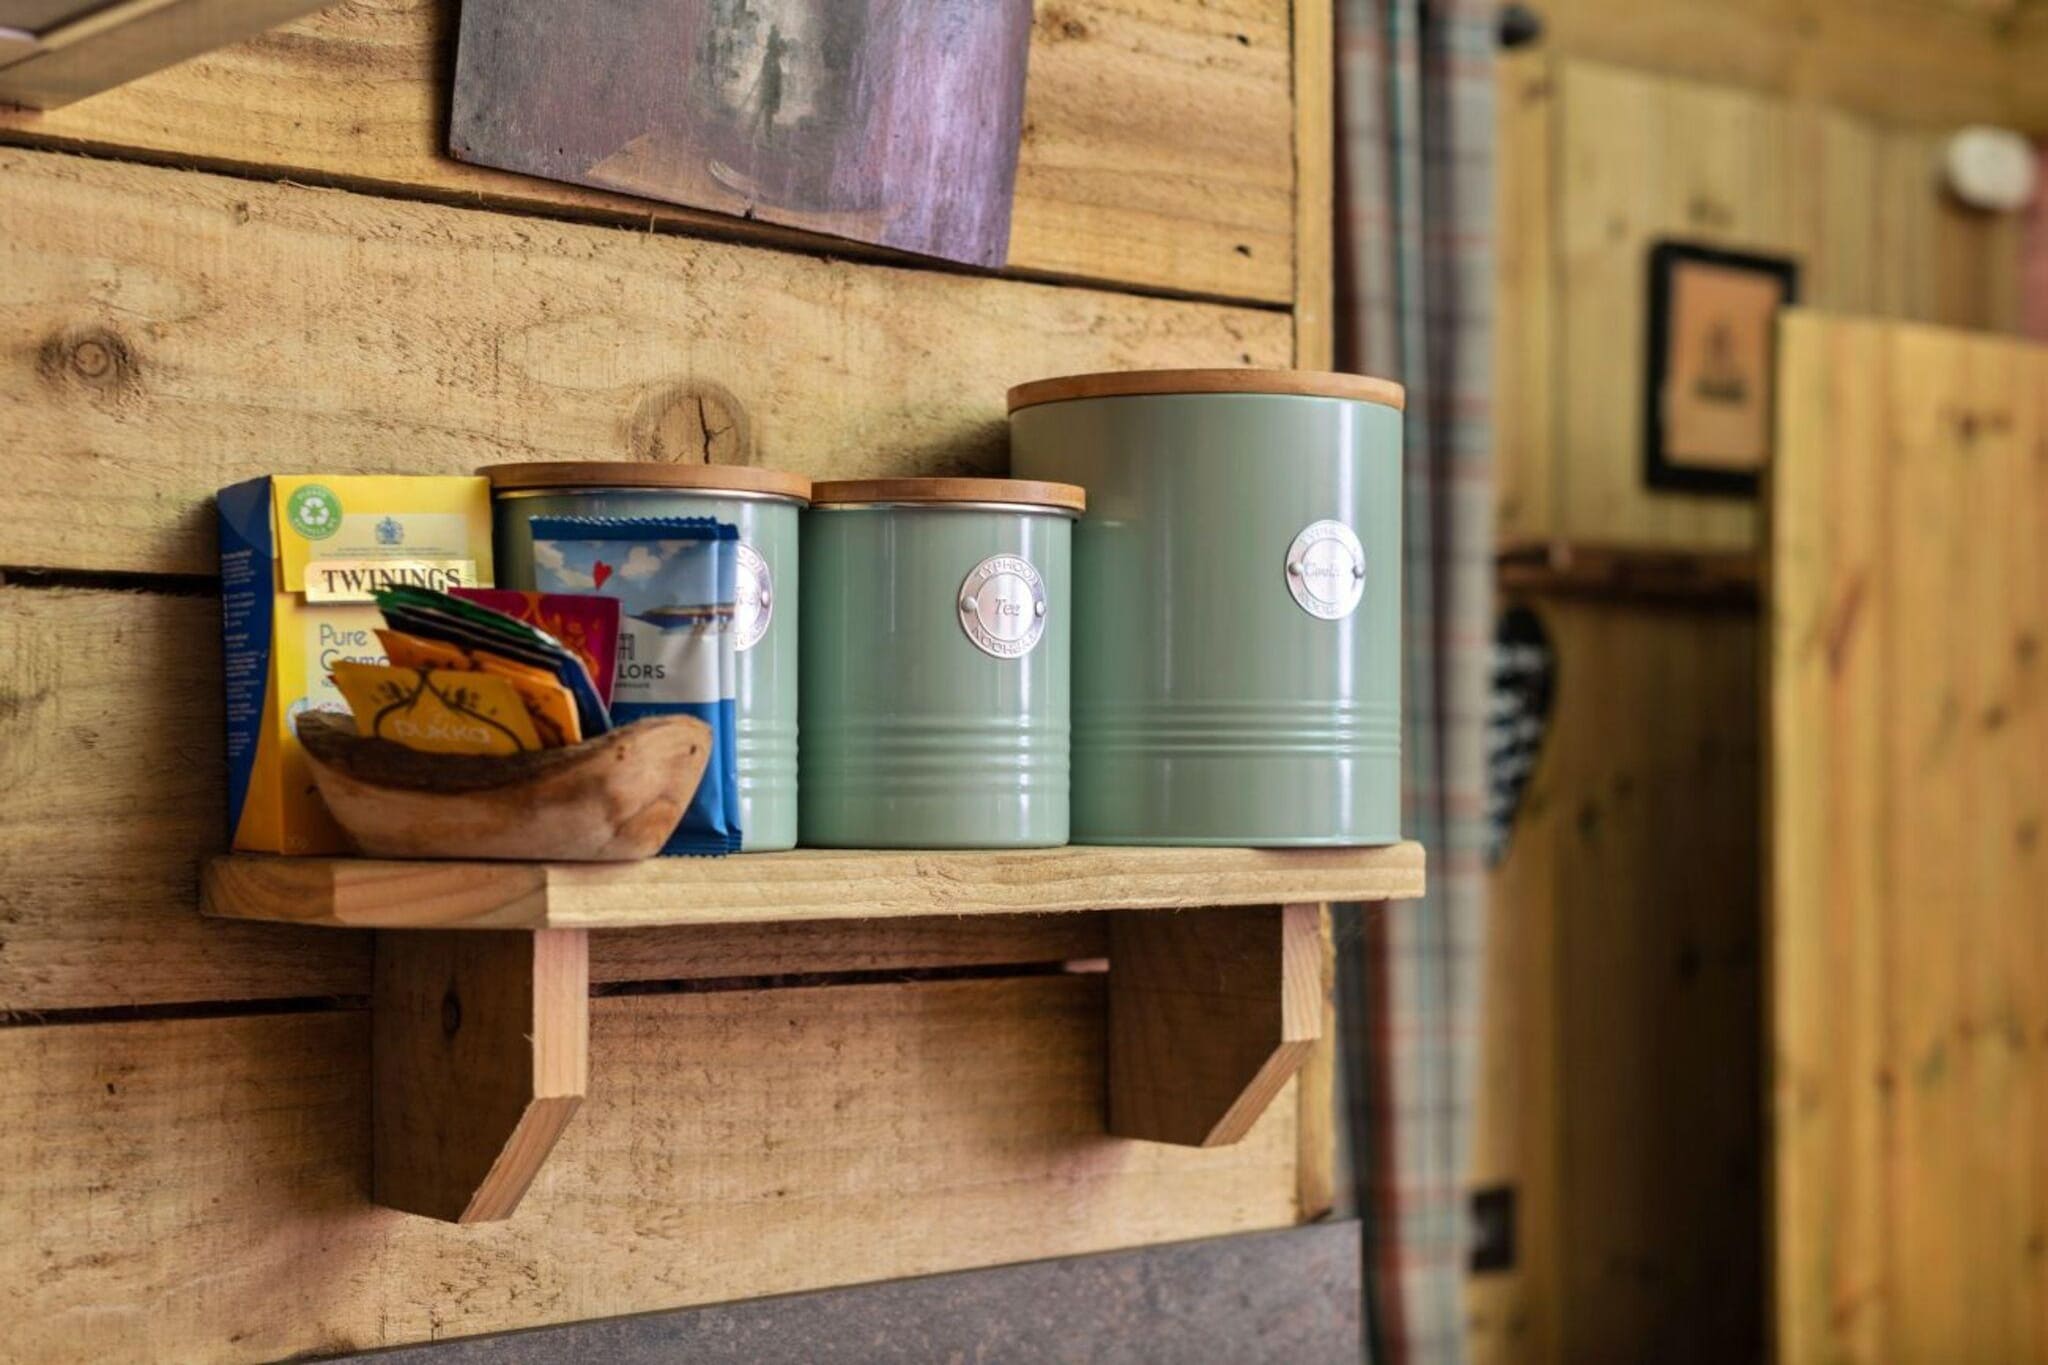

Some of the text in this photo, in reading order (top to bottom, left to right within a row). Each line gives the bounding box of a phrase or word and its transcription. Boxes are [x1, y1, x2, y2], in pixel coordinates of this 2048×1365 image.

[321, 567, 462, 594] TWININGS
[994, 598, 1021, 616] Tea
[320, 624, 367, 647] Pure
[618, 664, 666, 680] LORS
